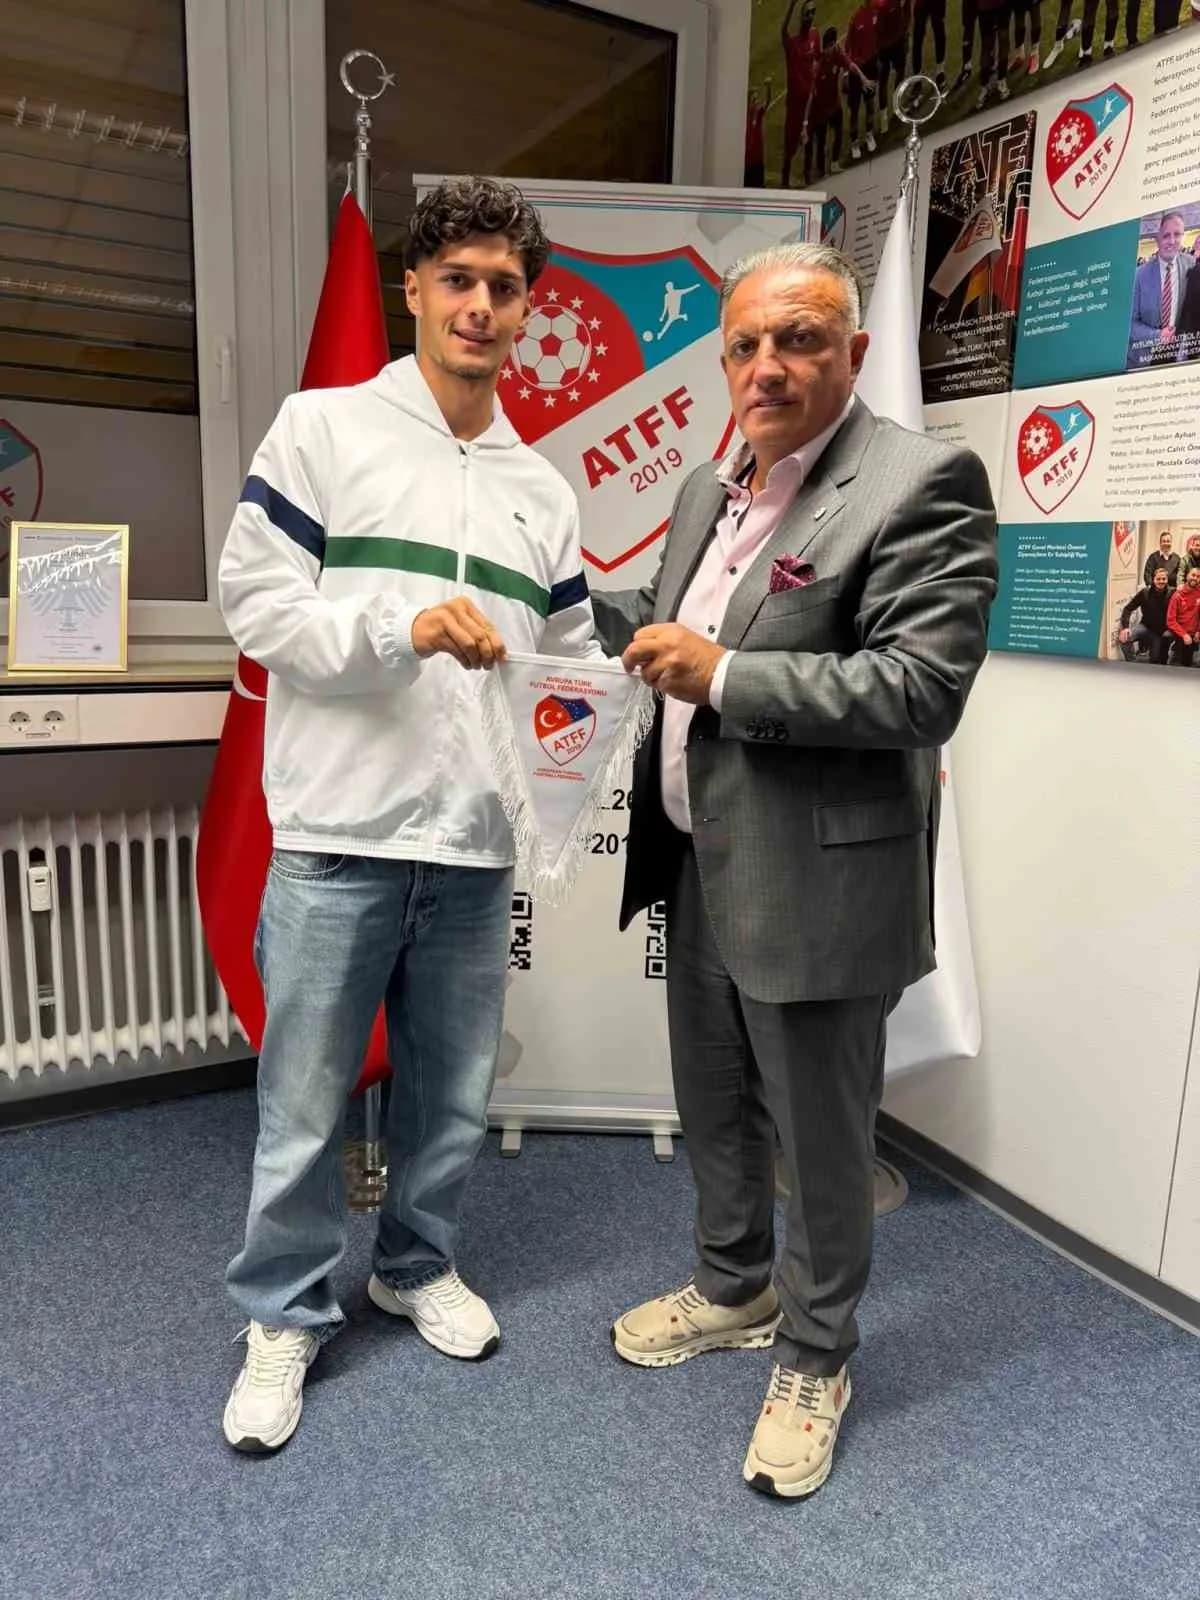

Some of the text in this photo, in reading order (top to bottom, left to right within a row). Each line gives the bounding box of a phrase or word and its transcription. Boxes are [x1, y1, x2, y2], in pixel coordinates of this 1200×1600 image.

[1075, 136, 1114, 189] ATFF
[582, 385, 694, 489] ATFF
[630, 447, 682, 493] 2019
[1043, 447, 1079, 486] ATFF
[530, 681, 555, 691] FUTBOL
[546, 676, 573, 685] AVRUPA
[554, 727, 586, 752] ATFF
